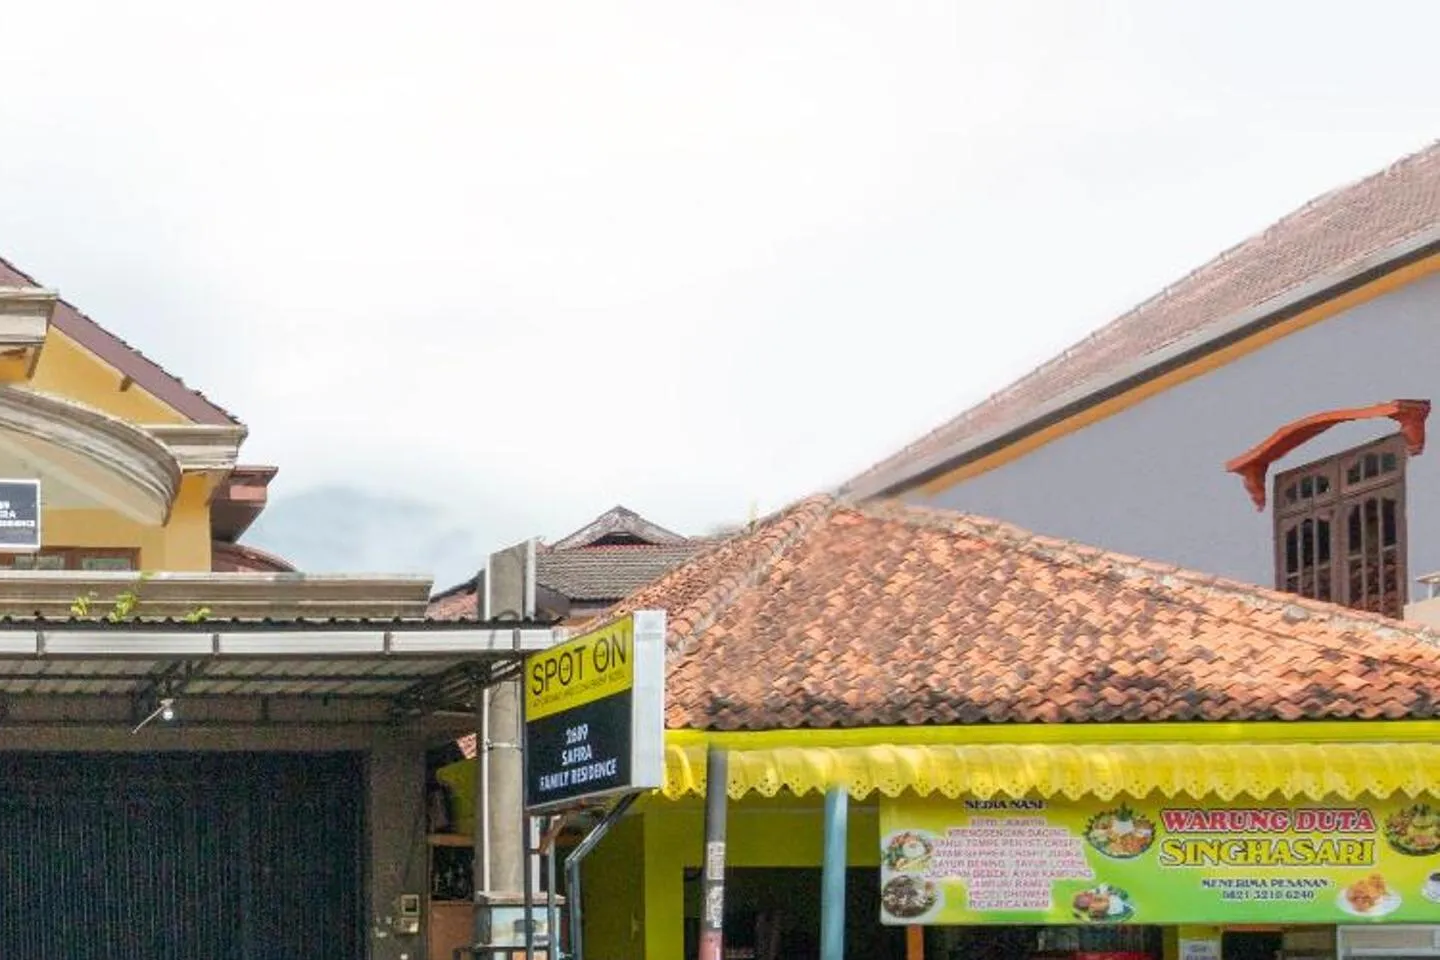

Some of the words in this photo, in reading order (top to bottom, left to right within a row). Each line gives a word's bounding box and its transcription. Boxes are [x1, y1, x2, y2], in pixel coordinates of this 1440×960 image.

[532, 645, 586, 697] SPOT
[592, 632, 627, 673] ON
[561, 745, 593, 766] SAFIRA
[539, 770, 569, 792] FAMILY
[571, 757, 618, 786] RESIDENCE
[1161, 808, 1288, 834] WARUNG
[1293, 808, 1376, 834] DUTA
[1160, 838, 1375, 867] SINGHASARI
[1201, 879, 1268, 888] MENERIMA
